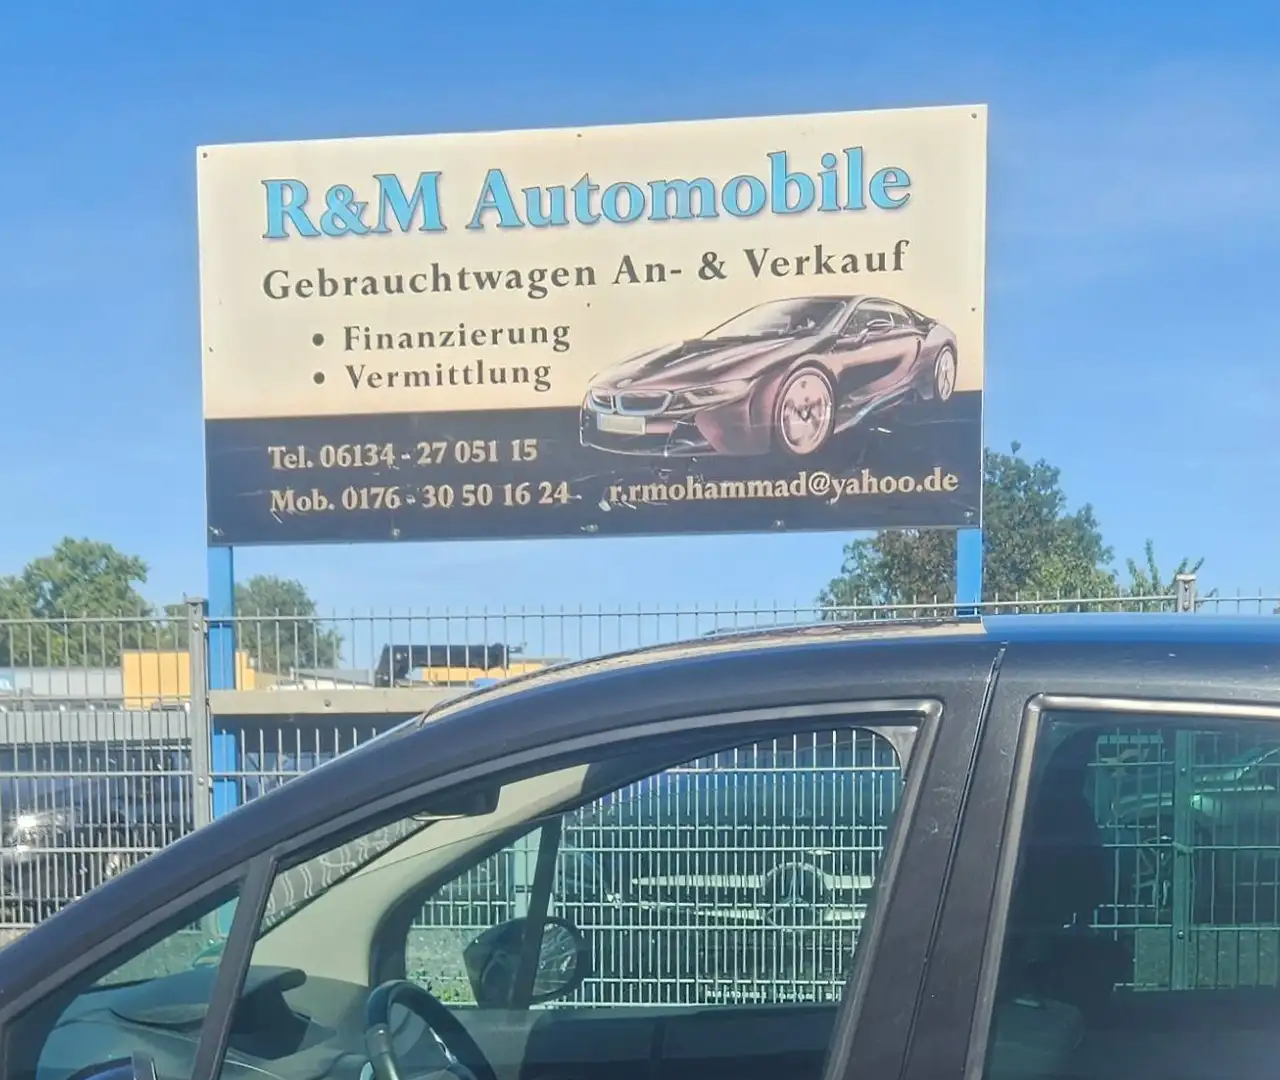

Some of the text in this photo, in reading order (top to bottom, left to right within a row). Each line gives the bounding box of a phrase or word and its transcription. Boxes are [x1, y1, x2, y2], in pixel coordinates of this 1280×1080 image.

[261, 146, 911, 239] R&M Automobile
[262, 240, 910, 300] Gebrauchtwagen An- & Verkauf
[343, 323, 571, 353] Finanzierung
[345, 359, 552, 393] Vermittlung
[268, 446, 314, 469] Tel.
[319, 443, 395, 469] 06134
[417, 441, 448, 465] 27
[454, 440, 499, 463] 051
[511, 438, 538, 462] 15
[270, 487, 335, 512] Mob.
[341, 486, 402, 510] 0176
[422, 485, 455, 508] 30
[462, 484, 493, 507] 50
[503, 482, 531, 506] 16
[538, 481, 569, 504] 24
[608, 466, 960, 502] r.rmohammad@yahoo.de
